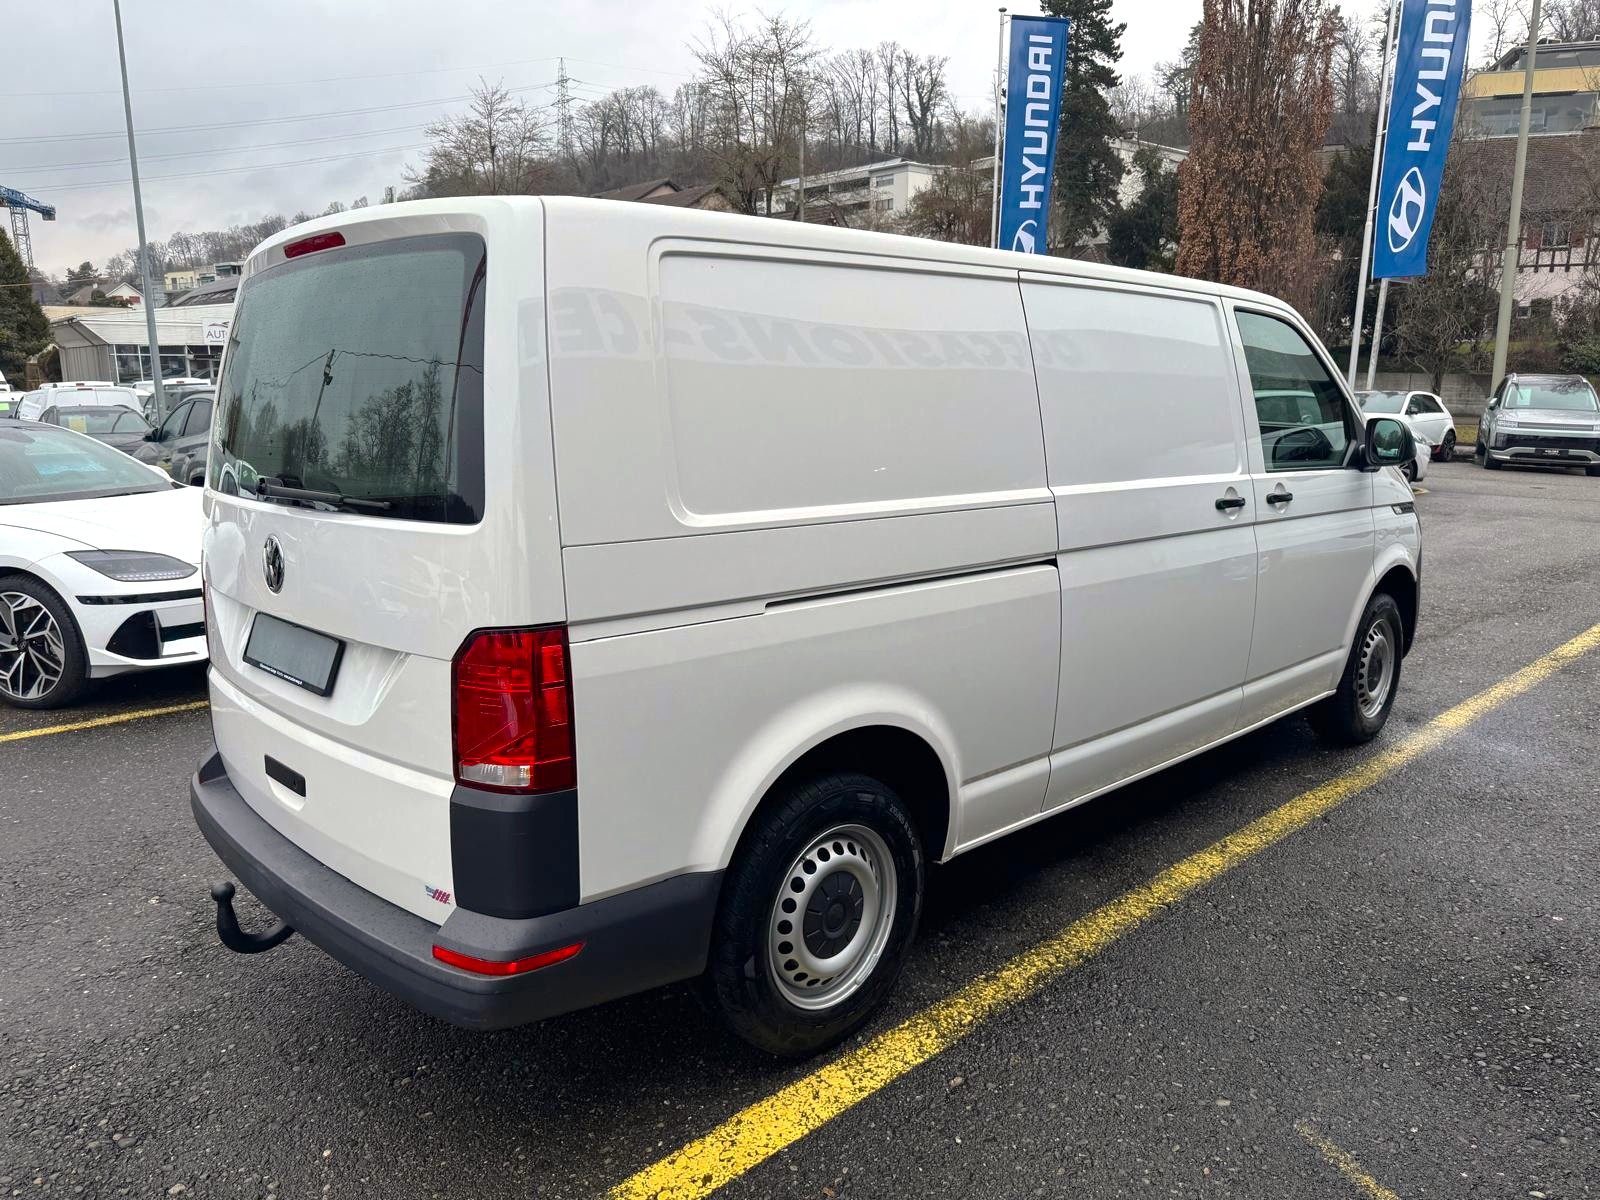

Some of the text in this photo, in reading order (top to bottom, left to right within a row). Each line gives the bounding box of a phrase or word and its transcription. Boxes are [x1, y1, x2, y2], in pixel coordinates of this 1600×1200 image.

[1019, 34, 1053, 209] HYUNDAI
[1407, 0, 1456, 152] HYUN
[206, 330, 228, 339] AUT
